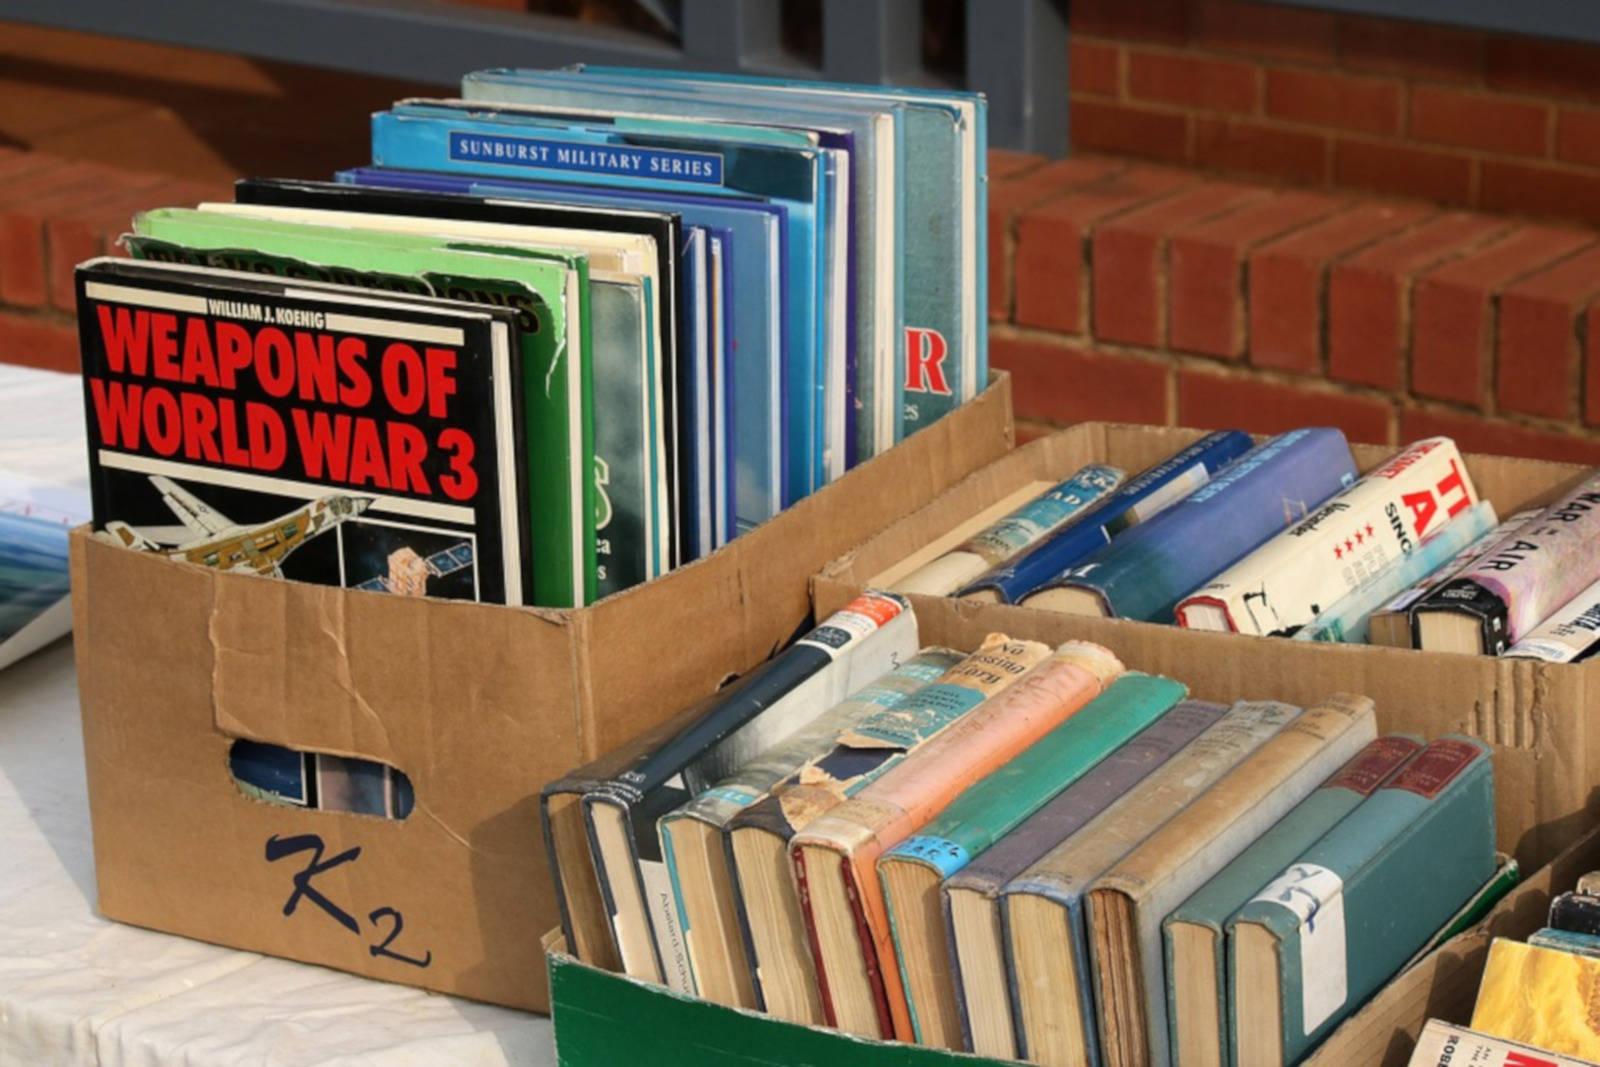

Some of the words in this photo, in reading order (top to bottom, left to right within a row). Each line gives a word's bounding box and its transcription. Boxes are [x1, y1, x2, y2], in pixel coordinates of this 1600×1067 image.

[460, 138, 550, 162] SUNBURST
[557, 148, 642, 171] MILITARY
[650, 156, 713, 177] SERIES
[208, 299, 263, 322] WILLIAM
[275, 307, 325, 329] KOENIG
[97, 305, 372, 408] WEAPONS
[381, 343, 457, 419] OF
[904, 326, 952, 396] R
[90, 379, 287, 471] WORLD
[292, 408, 431, 495] WAR
[437, 428, 478, 500] 3
[1478, 540, 1539, 571] AIR
